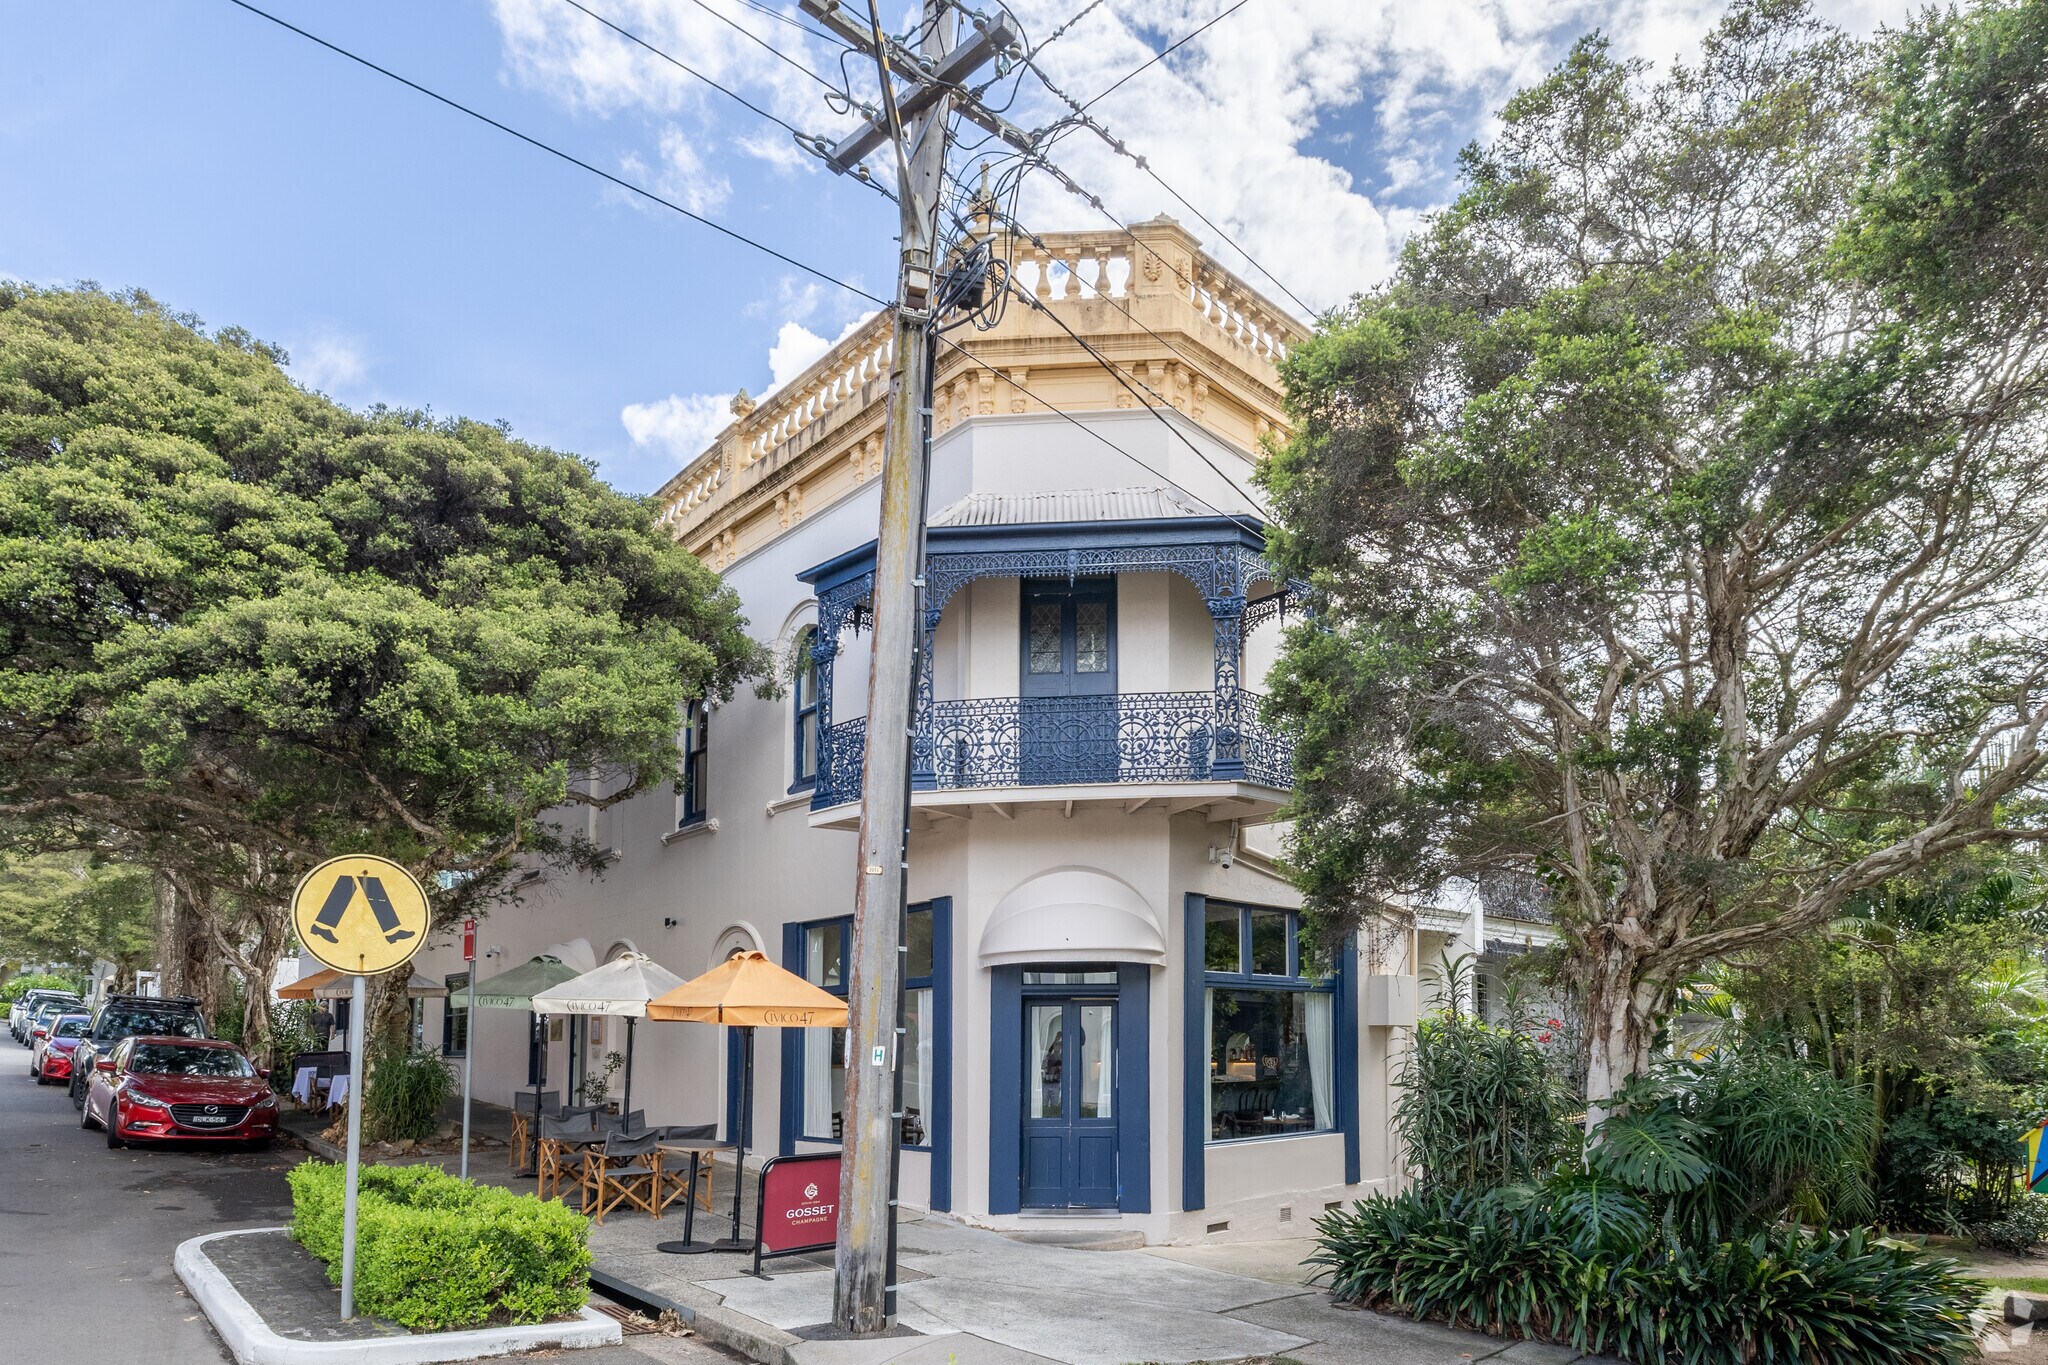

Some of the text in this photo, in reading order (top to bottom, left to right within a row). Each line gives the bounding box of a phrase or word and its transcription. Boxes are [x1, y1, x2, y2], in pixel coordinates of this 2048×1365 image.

[597, 1001, 612, 1012] 47
[764, 1009, 815, 1025] CIVICO 47
[874, 1049, 883, 1061] H
[786, 1204, 835, 1219] GOSSET
[791, 1216, 828, 1226] CHAMPAGNE
